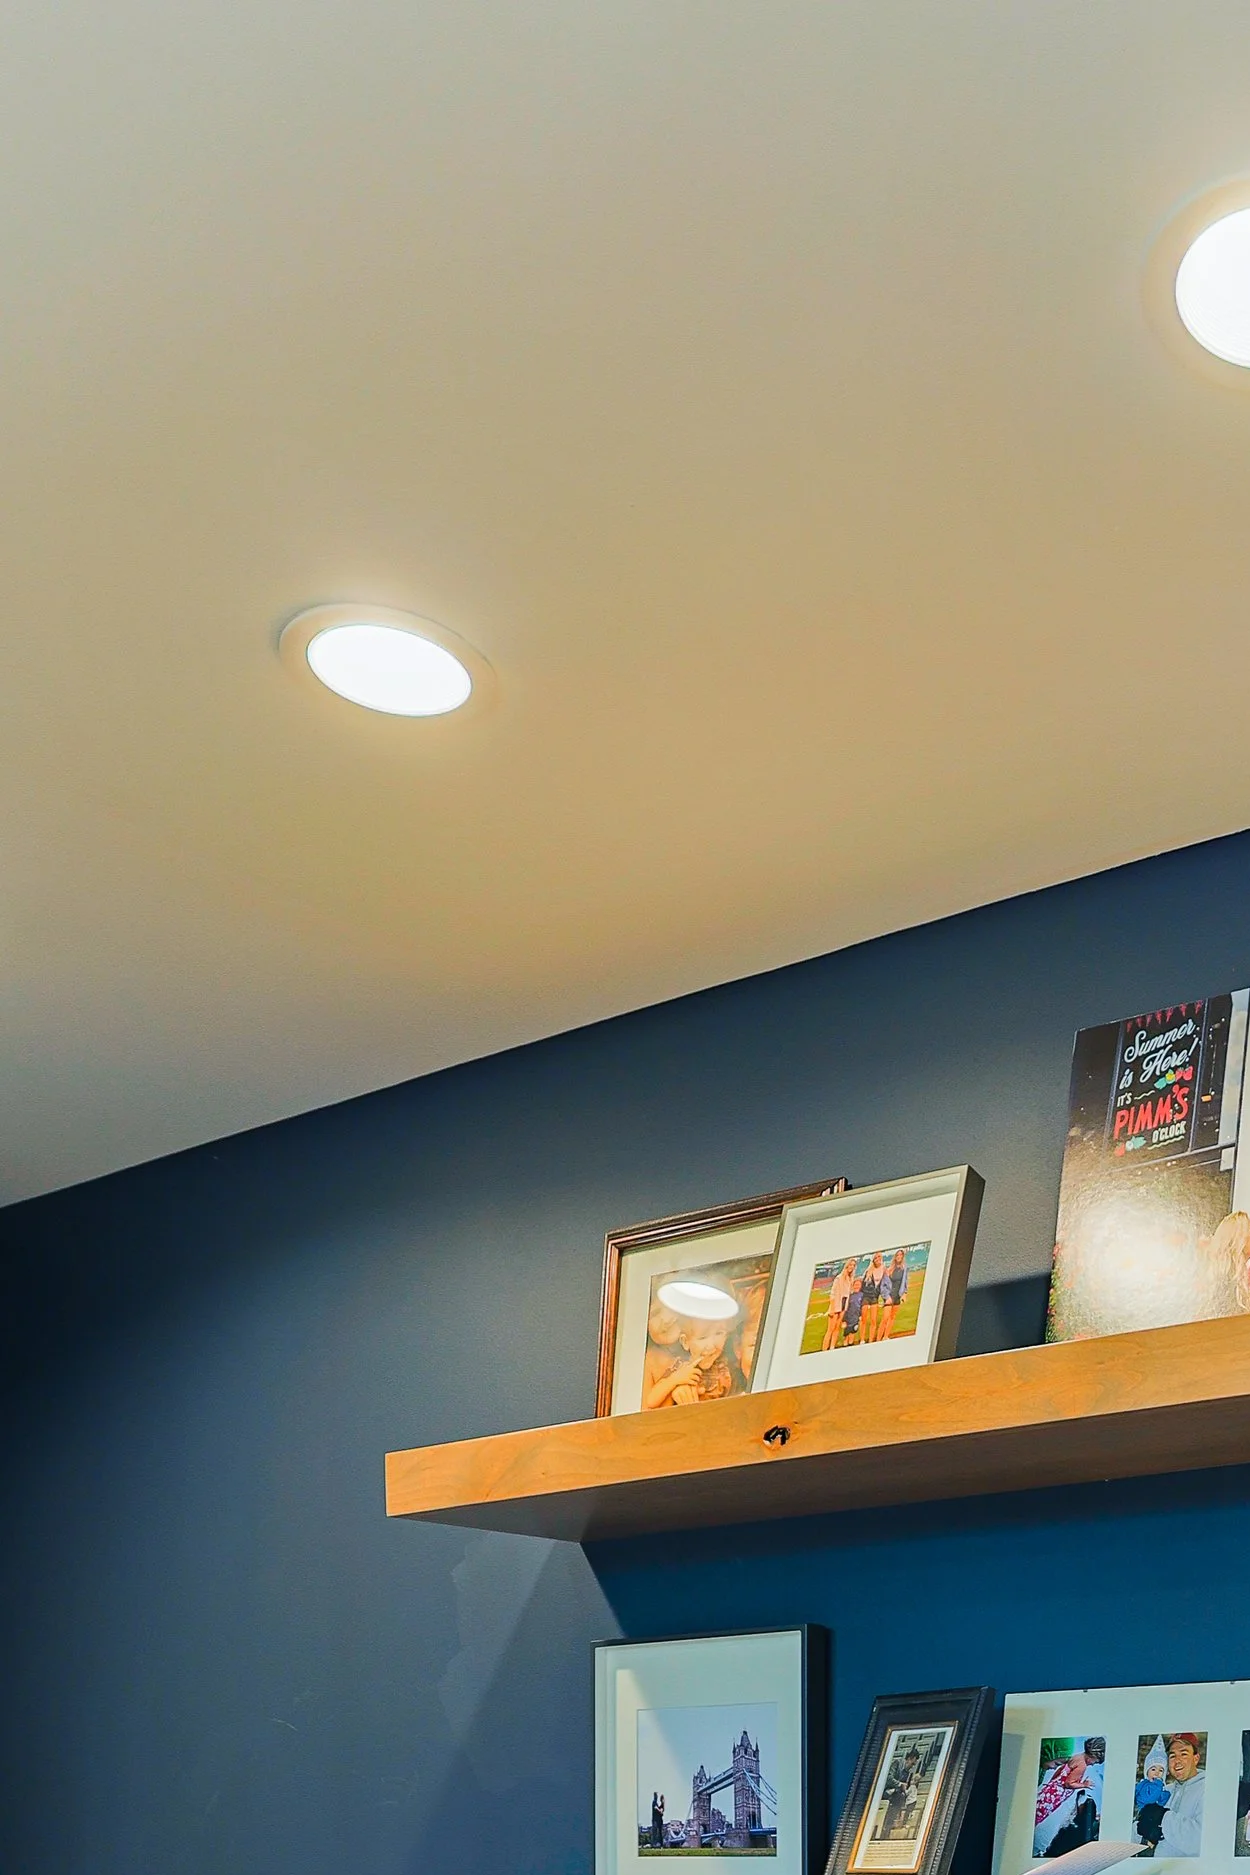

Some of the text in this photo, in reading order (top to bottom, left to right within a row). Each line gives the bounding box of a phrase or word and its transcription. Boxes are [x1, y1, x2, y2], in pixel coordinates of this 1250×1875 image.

[1119, 1036, 1199, 1090] is Here!
[1124, 1018, 1196, 1063] Summer
[1113, 1083, 1191, 1141] PIMM'S
[1116, 1092, 1133, 1108] IT'S
[1151, 1121, 1187, 1143] O'CLOCK
